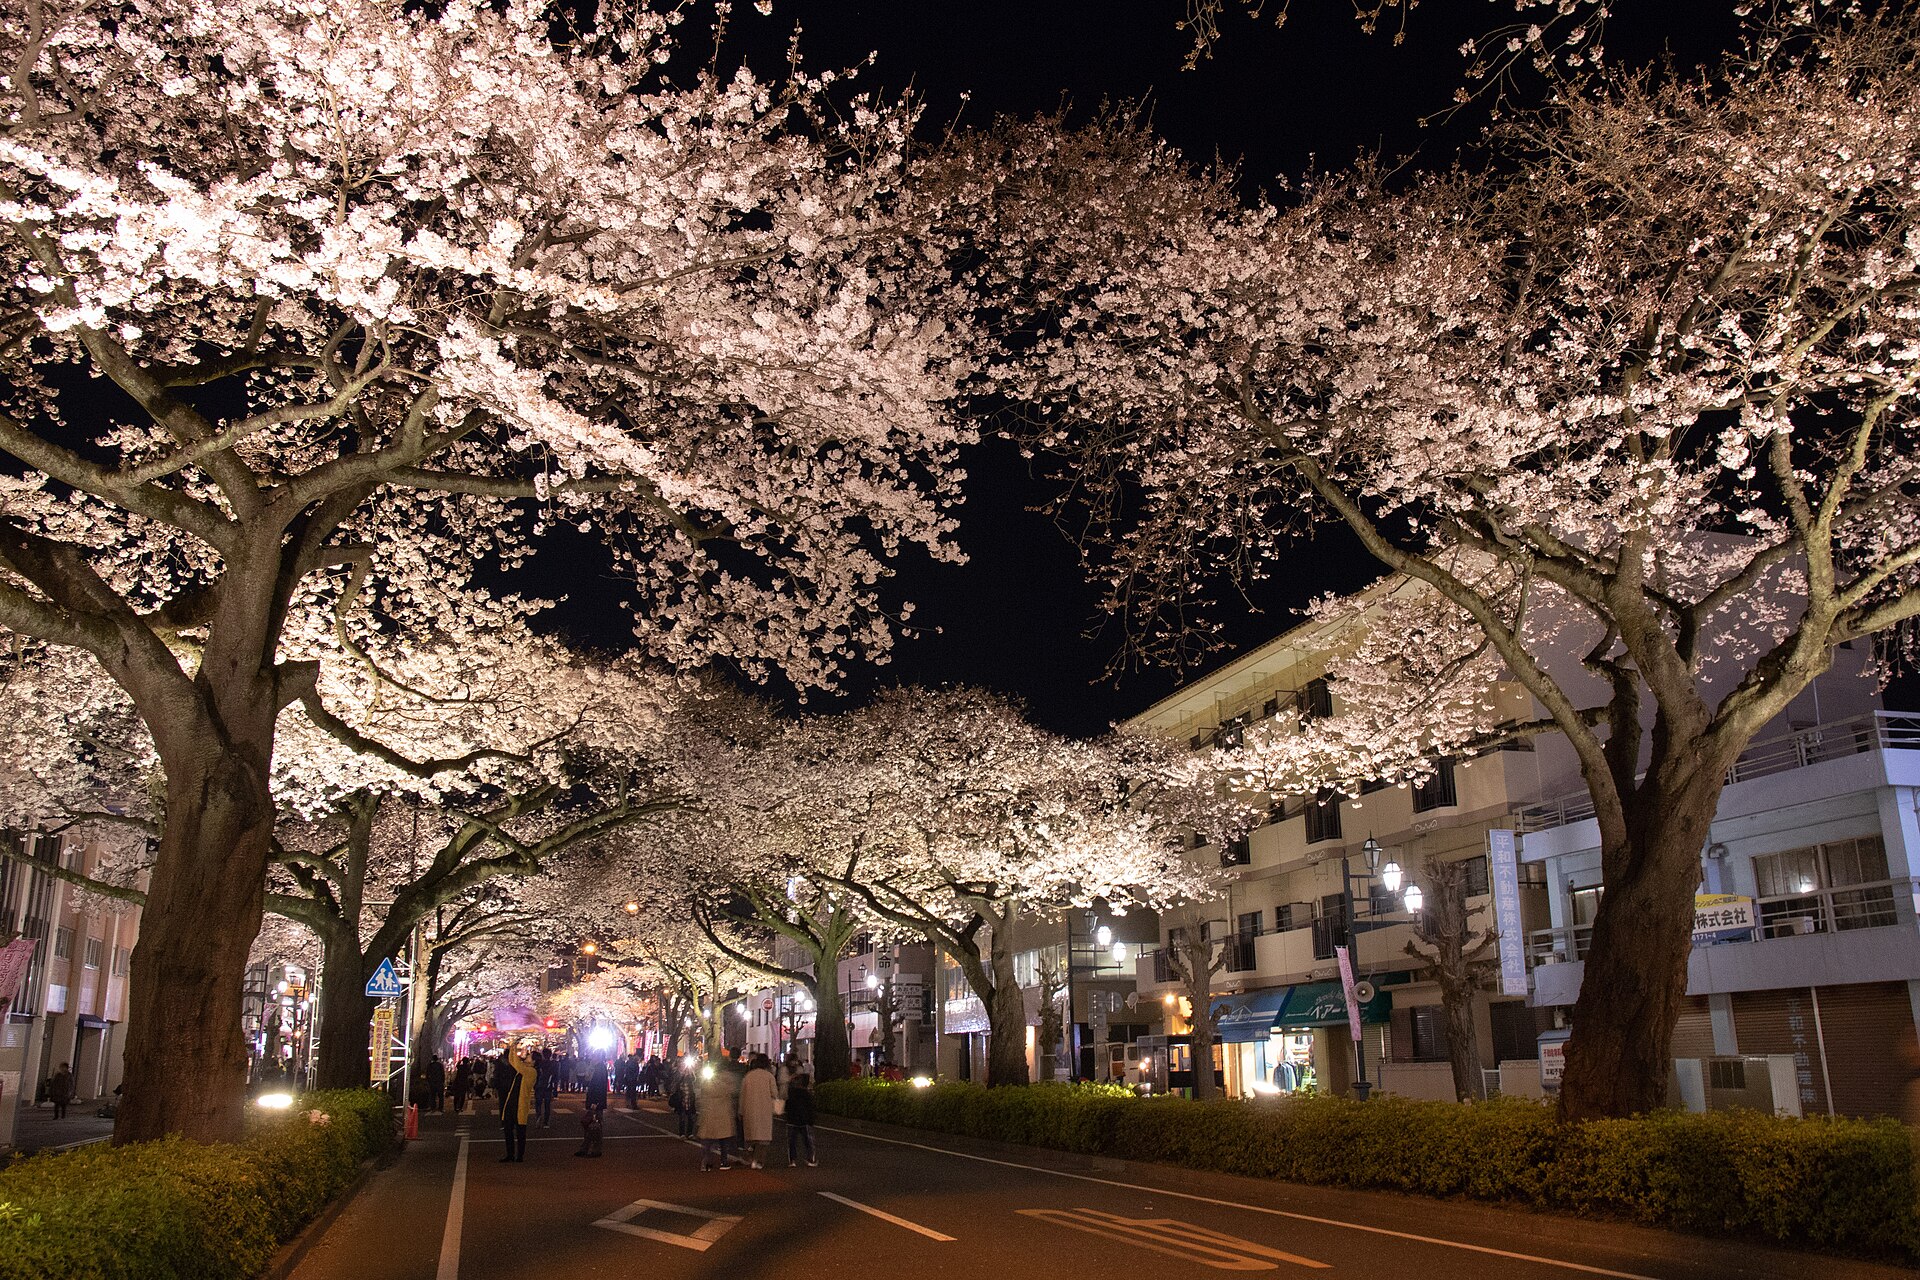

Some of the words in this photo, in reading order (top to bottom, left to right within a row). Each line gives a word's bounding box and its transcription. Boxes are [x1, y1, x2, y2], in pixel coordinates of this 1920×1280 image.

[1496, 834, 1521, 973] 平和不動産株式会社
[1694, 907, 1747, 929] 株式会社
